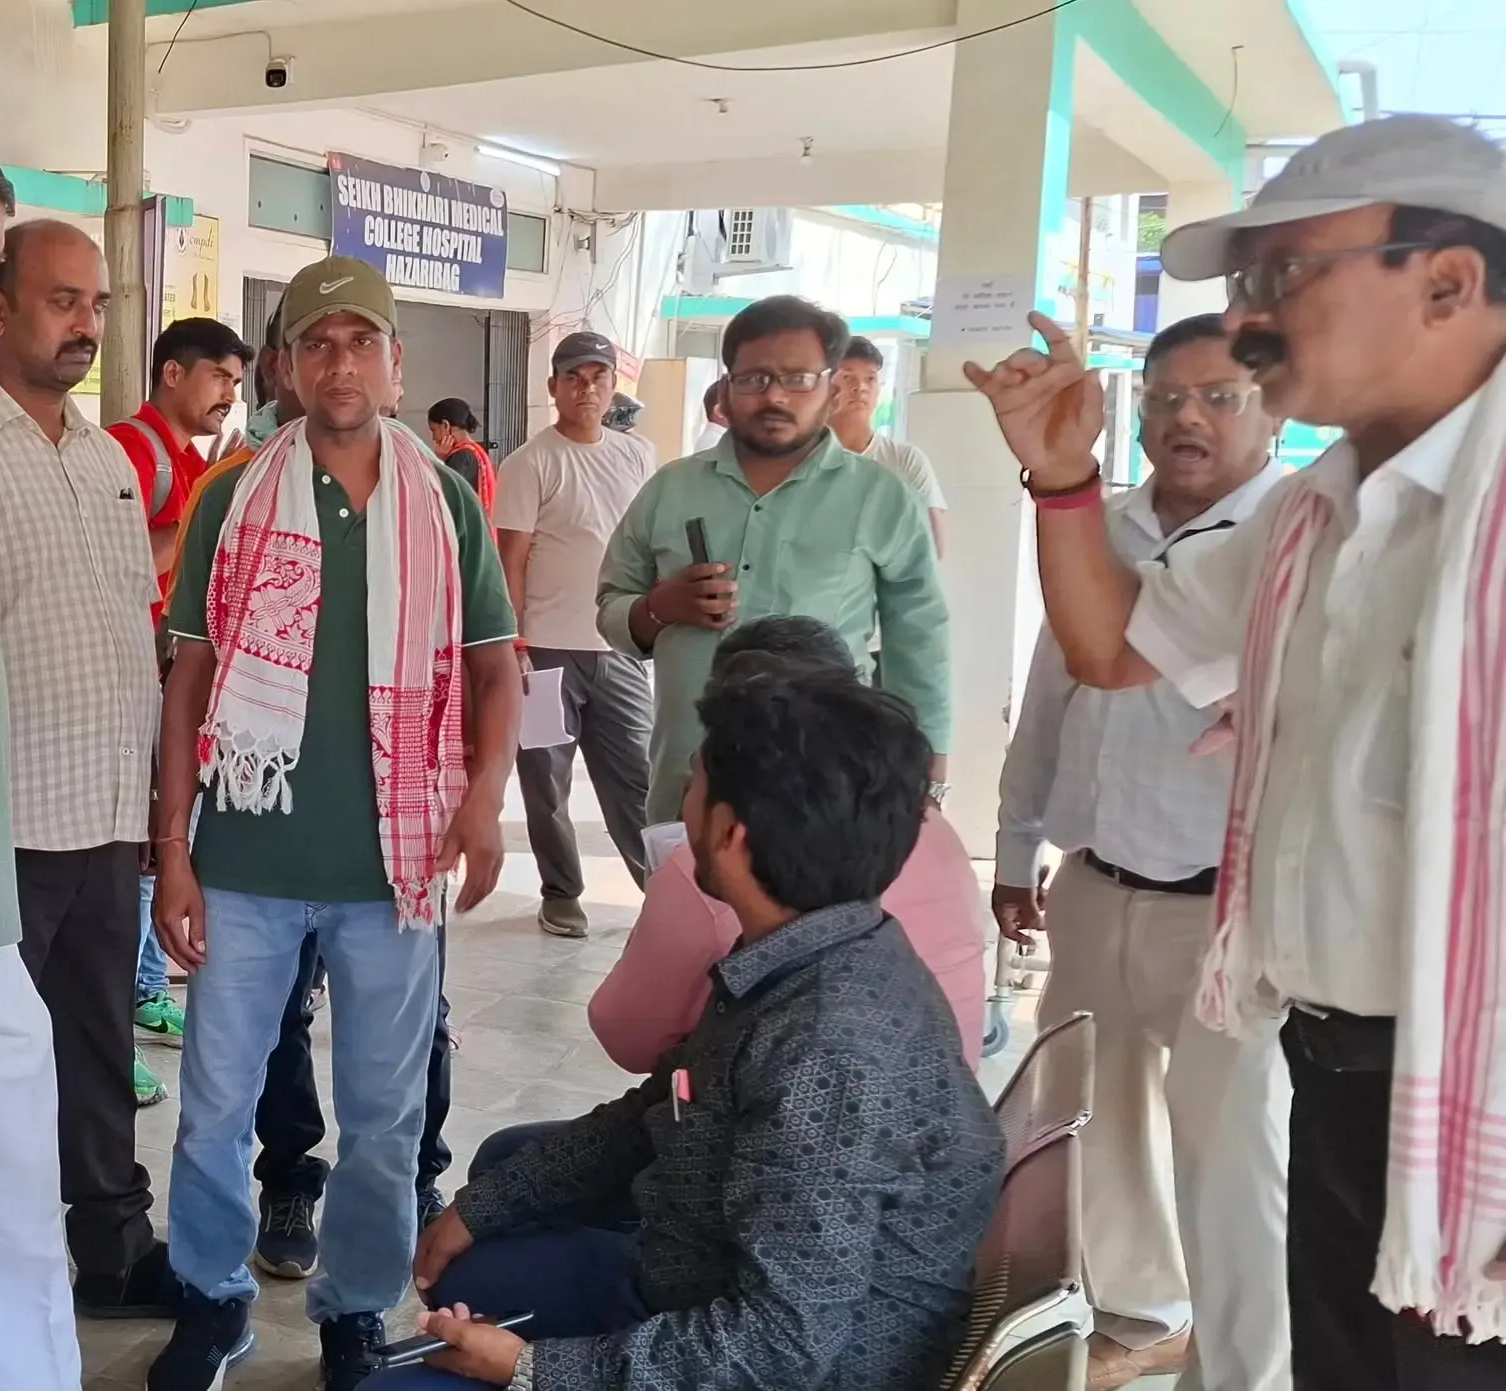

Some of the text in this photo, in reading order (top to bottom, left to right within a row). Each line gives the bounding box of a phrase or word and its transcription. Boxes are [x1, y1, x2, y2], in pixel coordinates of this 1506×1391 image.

[337, 175, 504, 236] SEIKH BHIKHARI MEDICAL
[364, 215, 482, 264] COLLEGE HOSPITAL
[386, 255, 460, 291] HAZARIBAG
